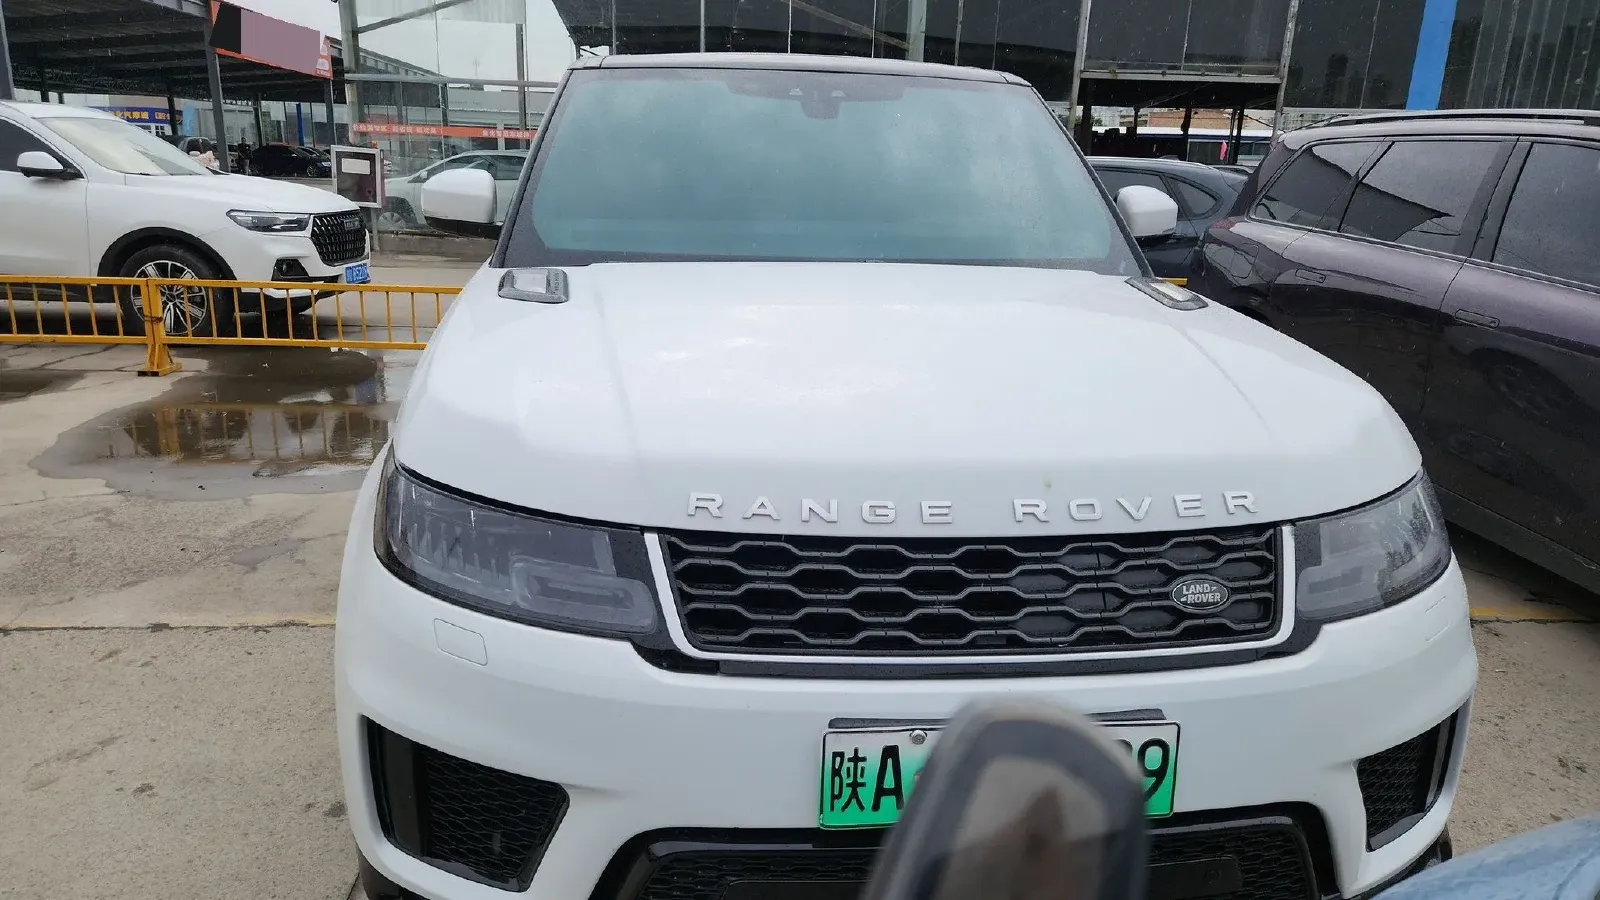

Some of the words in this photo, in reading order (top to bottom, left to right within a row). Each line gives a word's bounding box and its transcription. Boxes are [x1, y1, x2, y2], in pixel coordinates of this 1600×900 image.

[687, 492, 953, 524] RANGE
[1013, 490, 1259, 522] ROVER
[1182, 583, 1211, 595] LAND
[1187, 592, 1221, 604] ROVER
